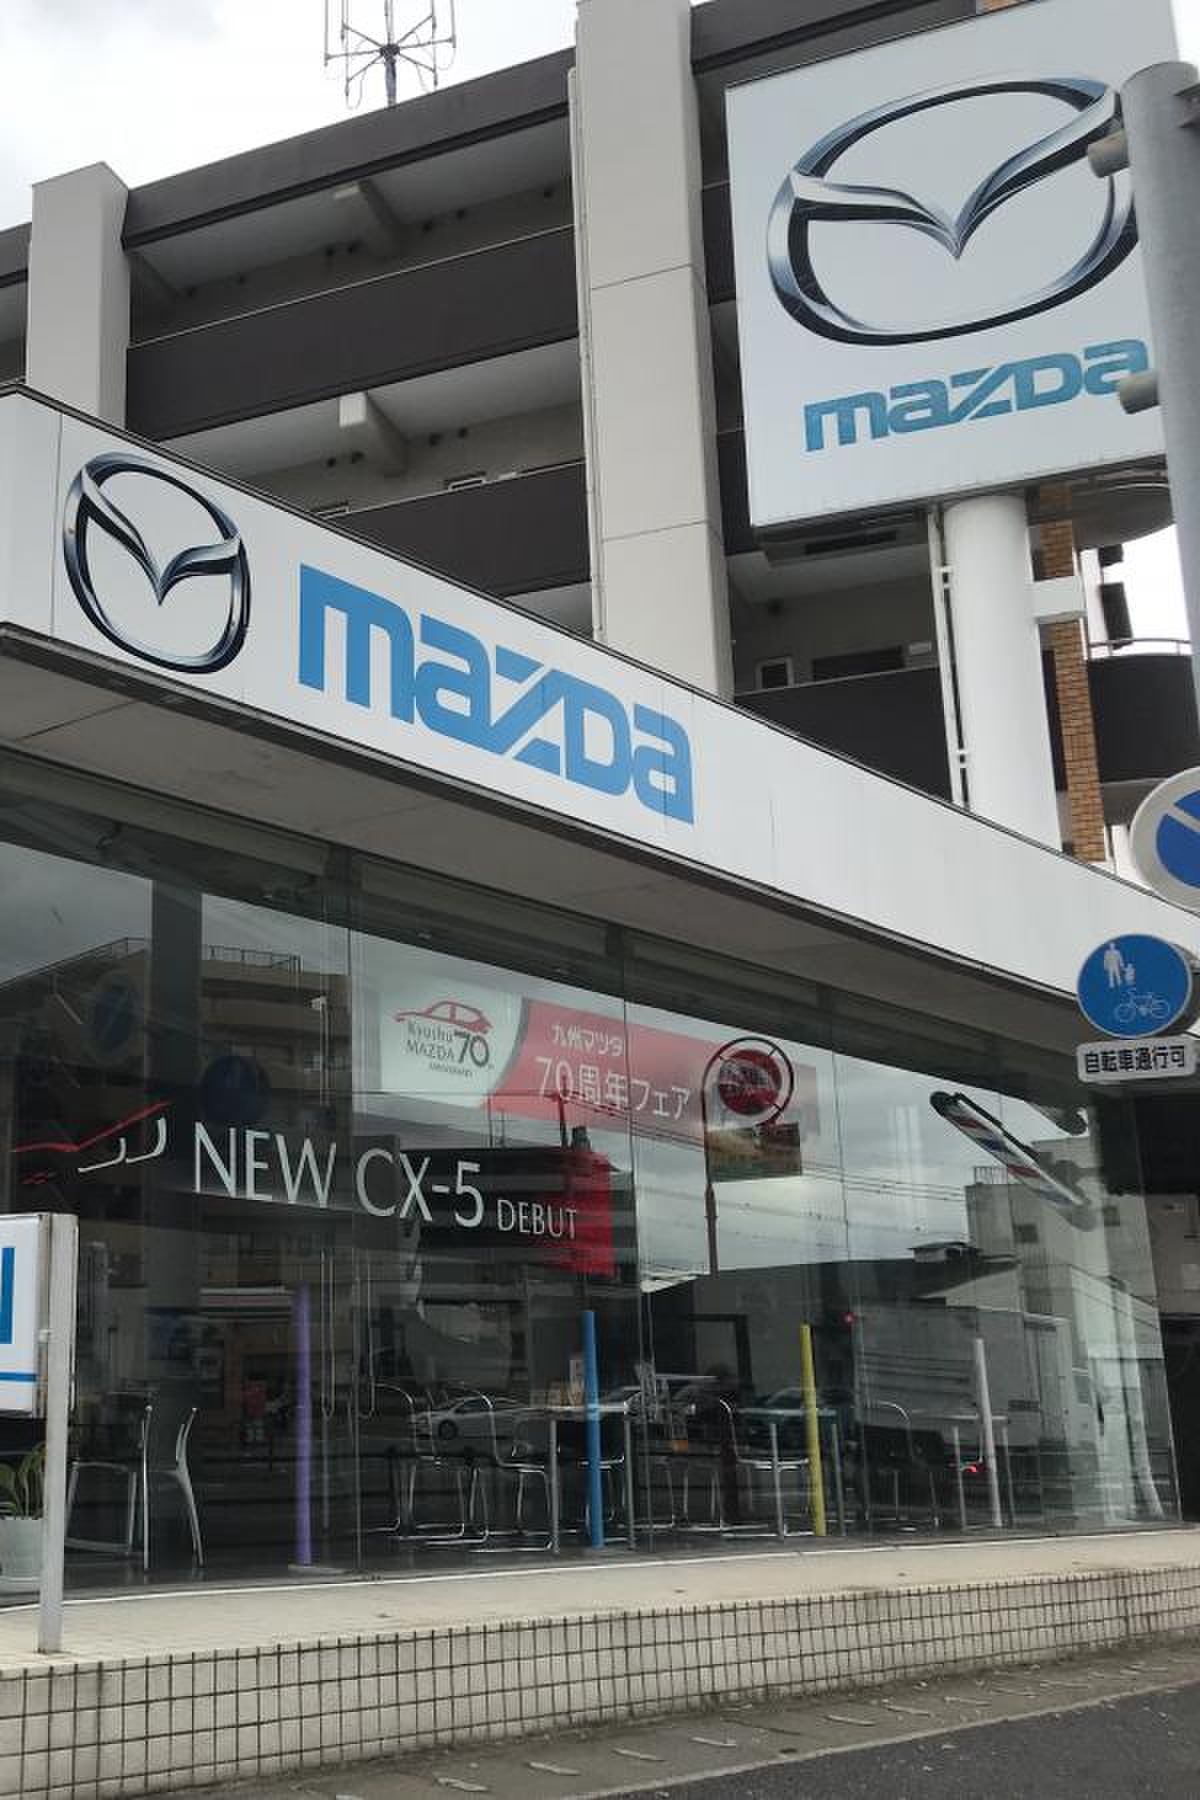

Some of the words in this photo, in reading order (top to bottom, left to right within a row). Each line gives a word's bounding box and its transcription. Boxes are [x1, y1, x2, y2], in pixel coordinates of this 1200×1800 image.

[453, 1029, 490, 1069] 70
[1085, 1045, 1185, 1073] 自転車通行可
[194, 1120, 337, 1209] NEW
[355, 1148, 485, 1229] CX-5
[497, 1199, 578, 1241] DEBUT
